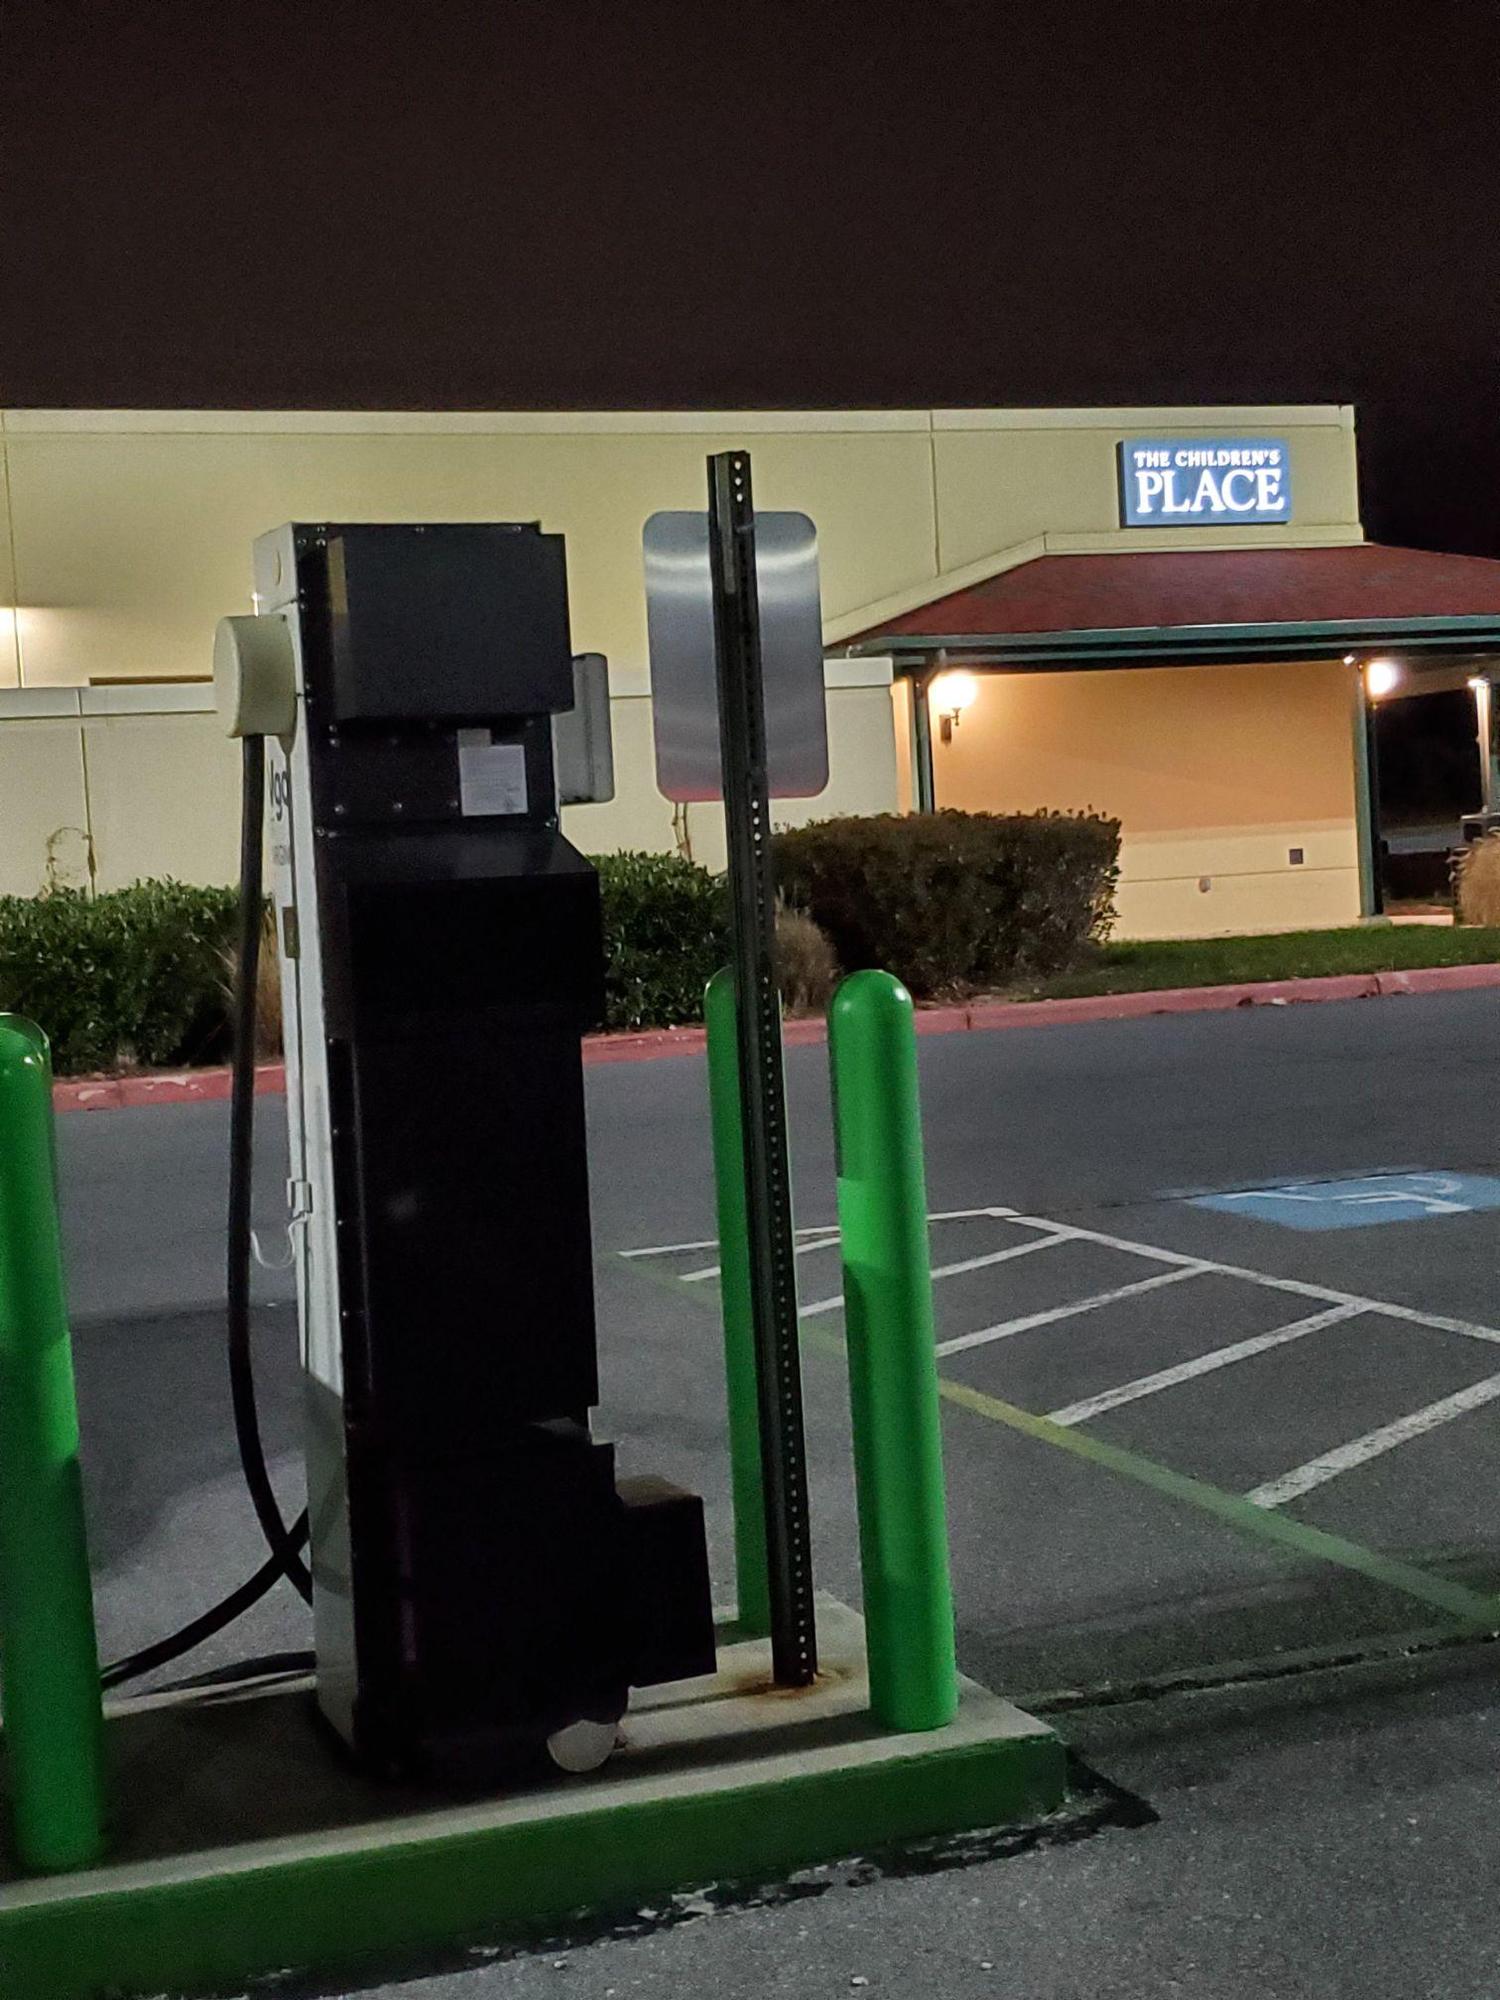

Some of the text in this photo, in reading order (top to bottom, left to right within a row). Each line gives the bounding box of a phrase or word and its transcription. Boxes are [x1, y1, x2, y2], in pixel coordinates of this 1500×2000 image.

[1133, 449, 1281, 468] THE CHILDREN'S
[1135, 468, 1285, 513] PLACE
